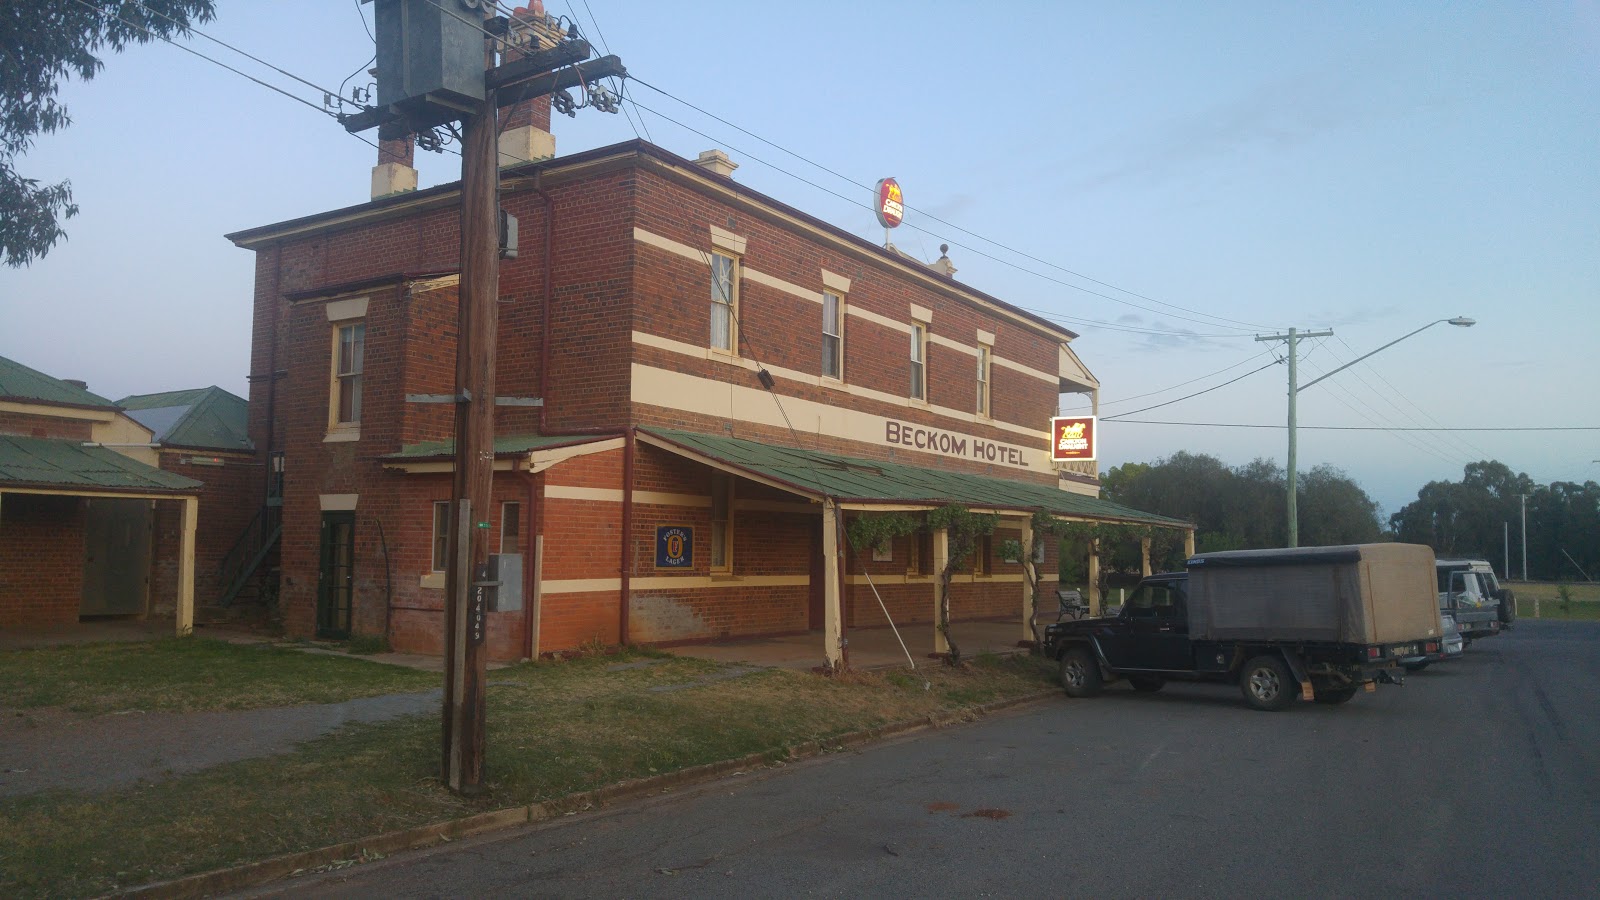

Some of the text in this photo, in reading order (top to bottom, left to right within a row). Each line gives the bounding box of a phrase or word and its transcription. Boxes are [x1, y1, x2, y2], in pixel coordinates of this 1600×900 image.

[886, 421, 1029, 466] BECKOM HOTEL
[665, 556, 684, 564] LAGER
